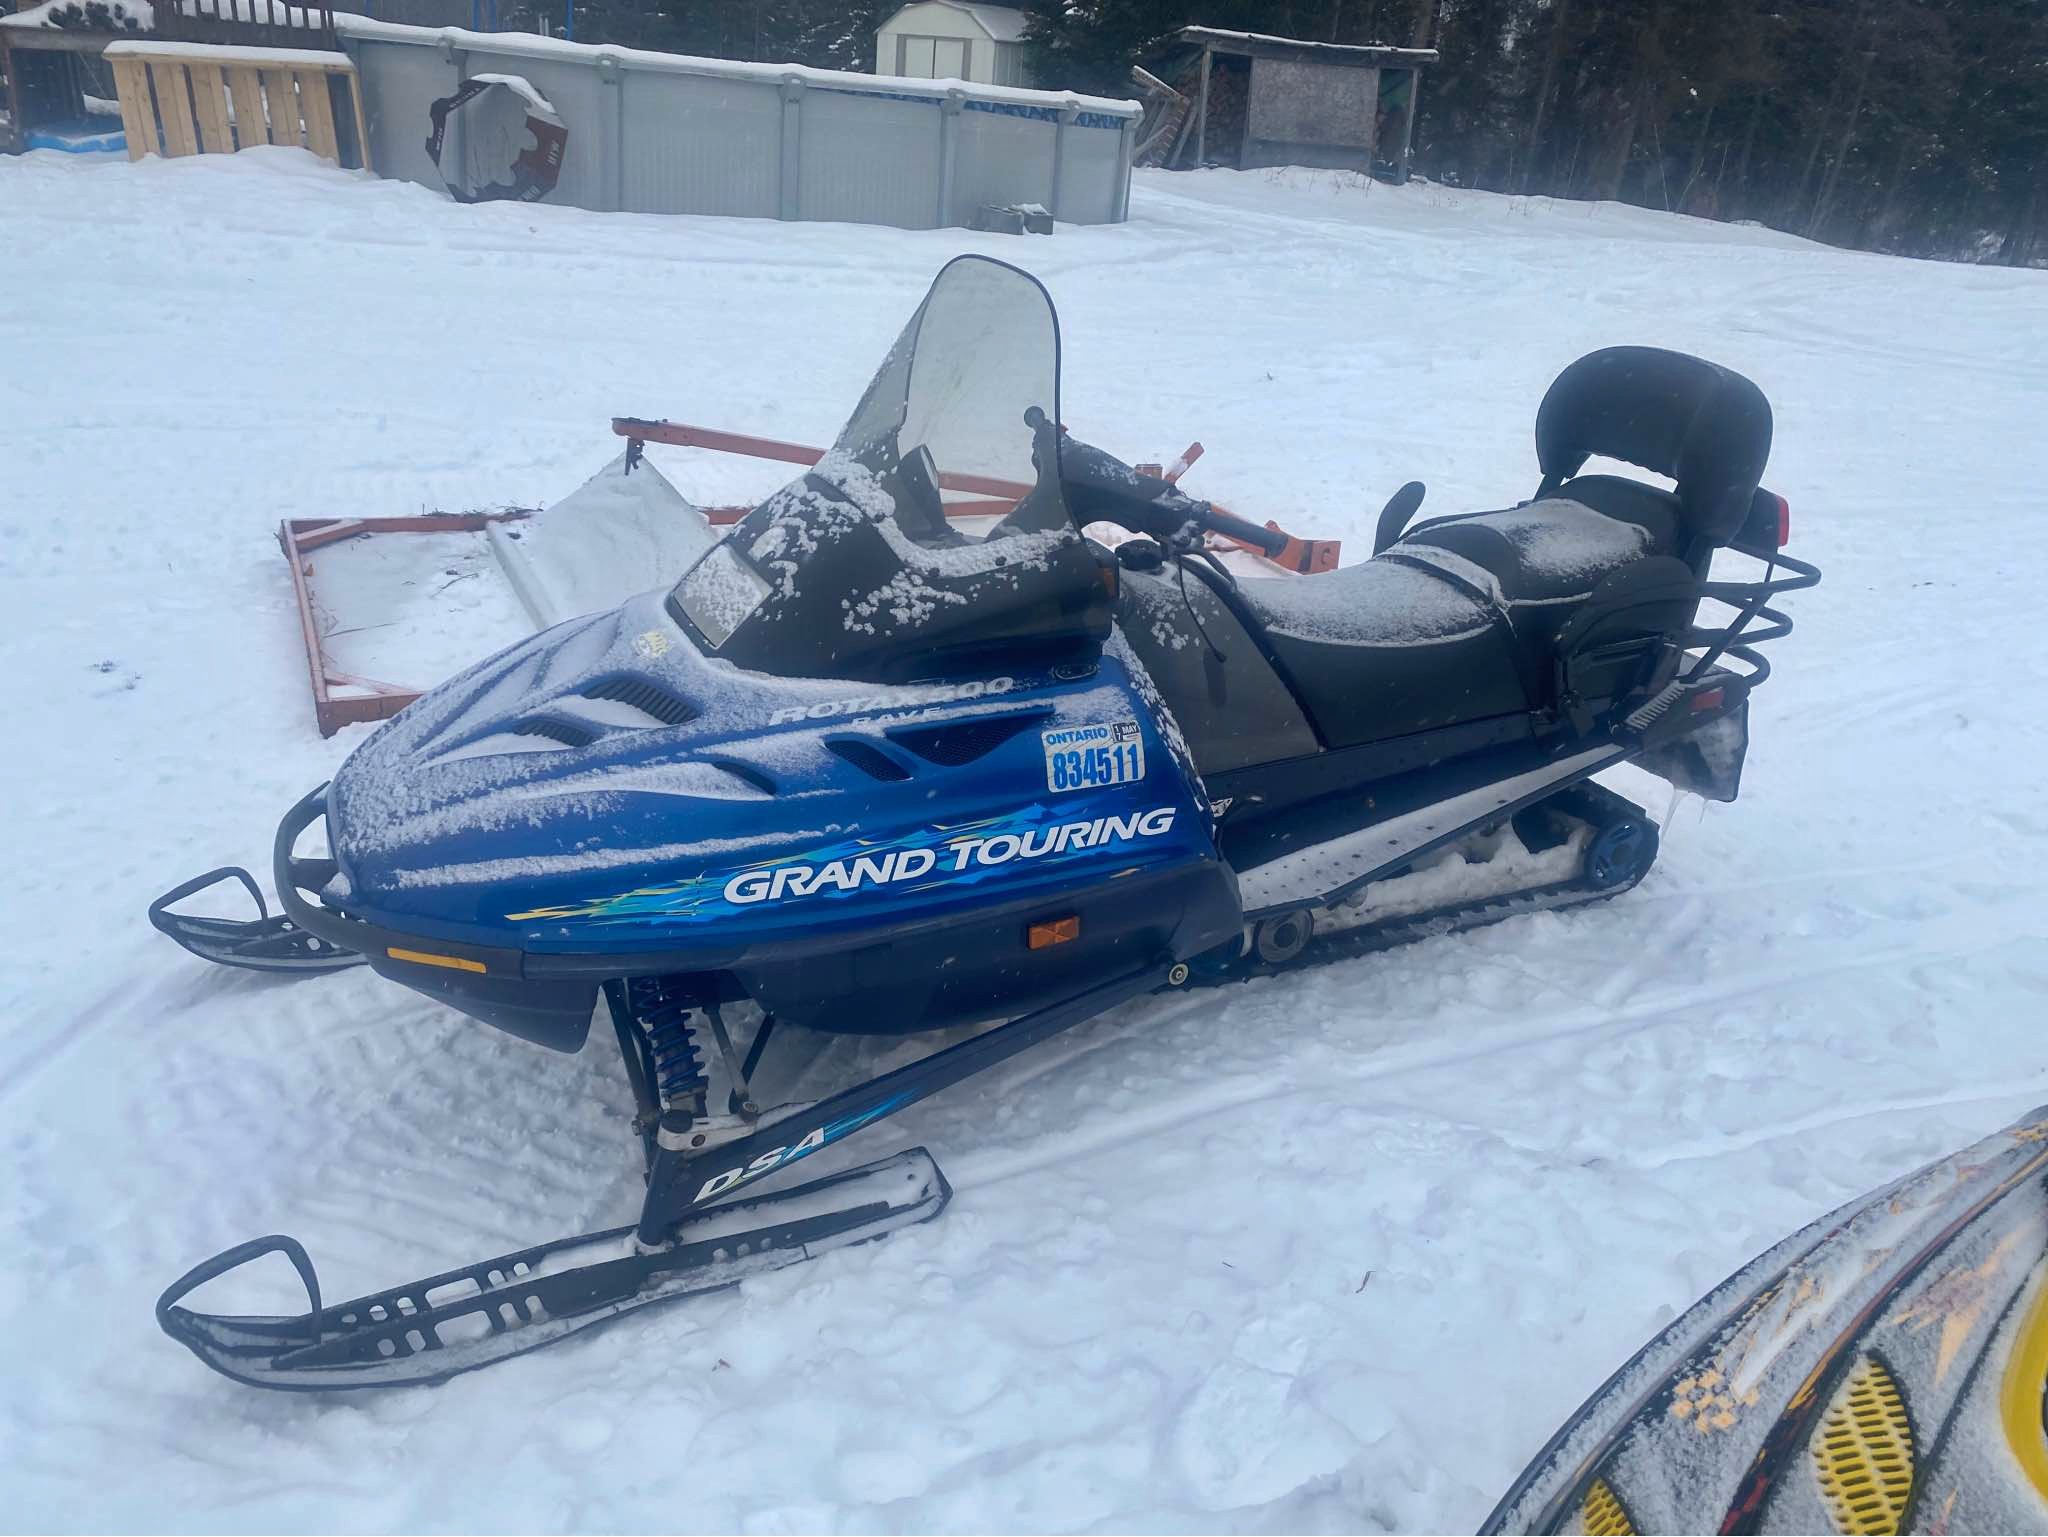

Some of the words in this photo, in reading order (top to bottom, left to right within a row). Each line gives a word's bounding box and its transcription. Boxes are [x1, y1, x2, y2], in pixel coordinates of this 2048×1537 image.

[1045, 727, 1109, 746] ONTARIO
[1121, 724, 1138, 736] MAY
[1052, 743, 1139, 790] 834511
[723, 847, 937, 904] GRAND
[948, 807, 1177, 872] TOURING
[693, 1127, 825, 1203] DSA
